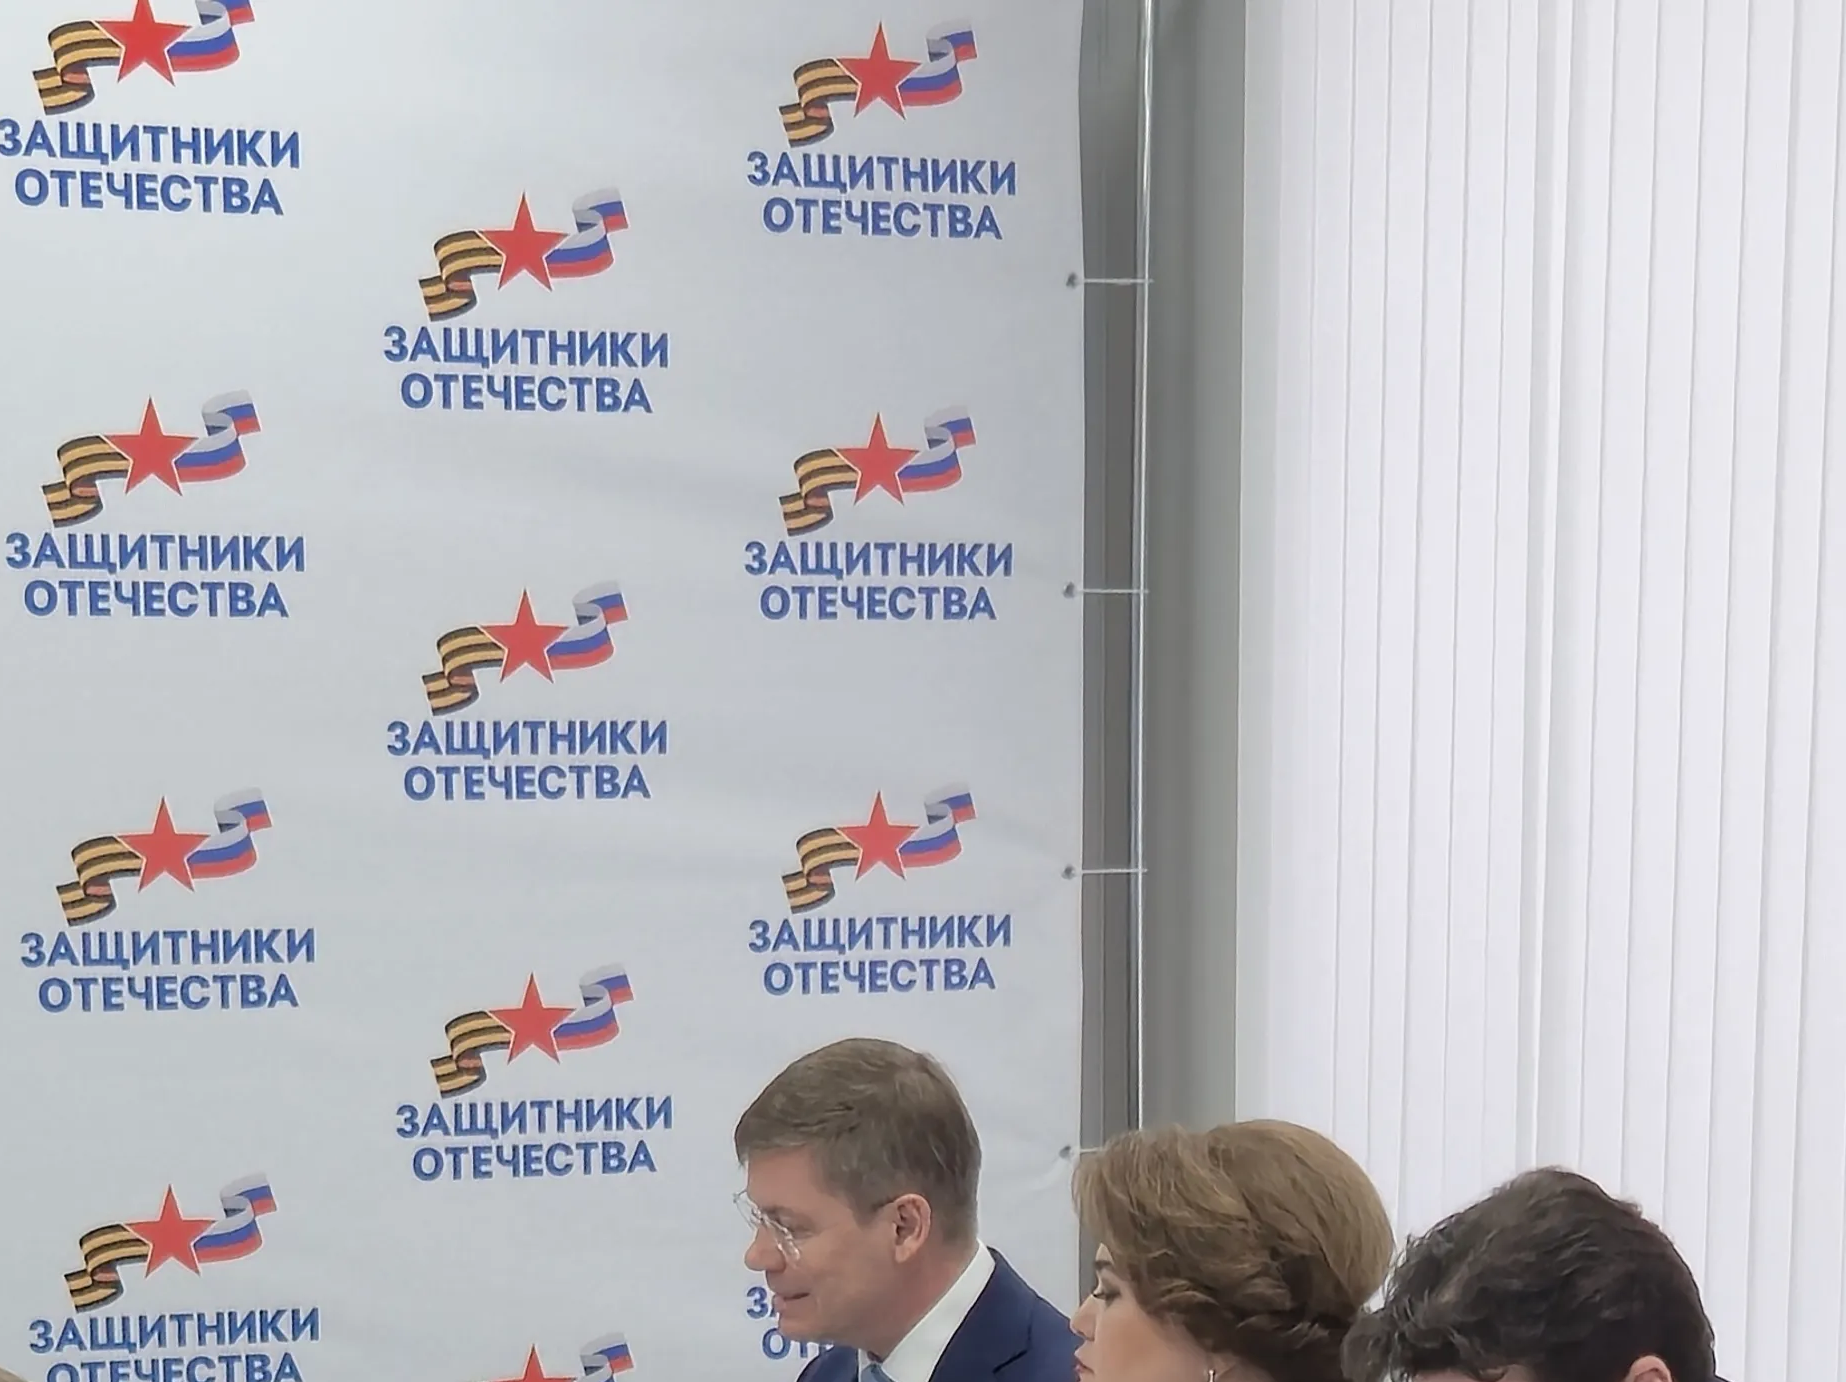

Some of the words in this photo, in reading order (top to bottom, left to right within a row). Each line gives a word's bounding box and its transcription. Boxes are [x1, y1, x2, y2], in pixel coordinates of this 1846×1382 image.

[12, 166, 283, 216] ОТЕЧЕСТВА
[748, 152, 1018, 195] ЗАЩИТНИКИ
[762, 196, 1000, 239] ОТЕЧЕСТВА
[383, 324, 670, 368] ЗАЩИТНИКИ
[399, 371, 651, 415] ОТЕЧЕСТВА
[4, 530, 306, 574] ЗАЩИТНИКИ
[745, 541, 1014, 580] ЗАЩИТНИКИ
[22, 578, 288, 619] ОТЕЧЕСТВА
[759, 583, 994, 621] ОТЕЧЕСТВА
[388, 718, 669, 760] ЗАЩИТНИКИ
[402, 763, 647, 802] ОТЕЧЕСТВА
[21, 928, 317, 971] ЗАЩИТНИКИ
[750, 915, 1011, 954] ЗАЩИТНИКИ
[37, 972, 298, 1014] ОТЕЧЕСТВА
[762, 957, 994, 995] ОТЕЧЕСТВА
[396, 1096, 674, 1139] ЗАЩИТНИКИ
[411, 1140, 655, 1182] ОТЕЧЕСТВА
[31, 1309, 321, 1354] ЗАЩИТНИКИ
